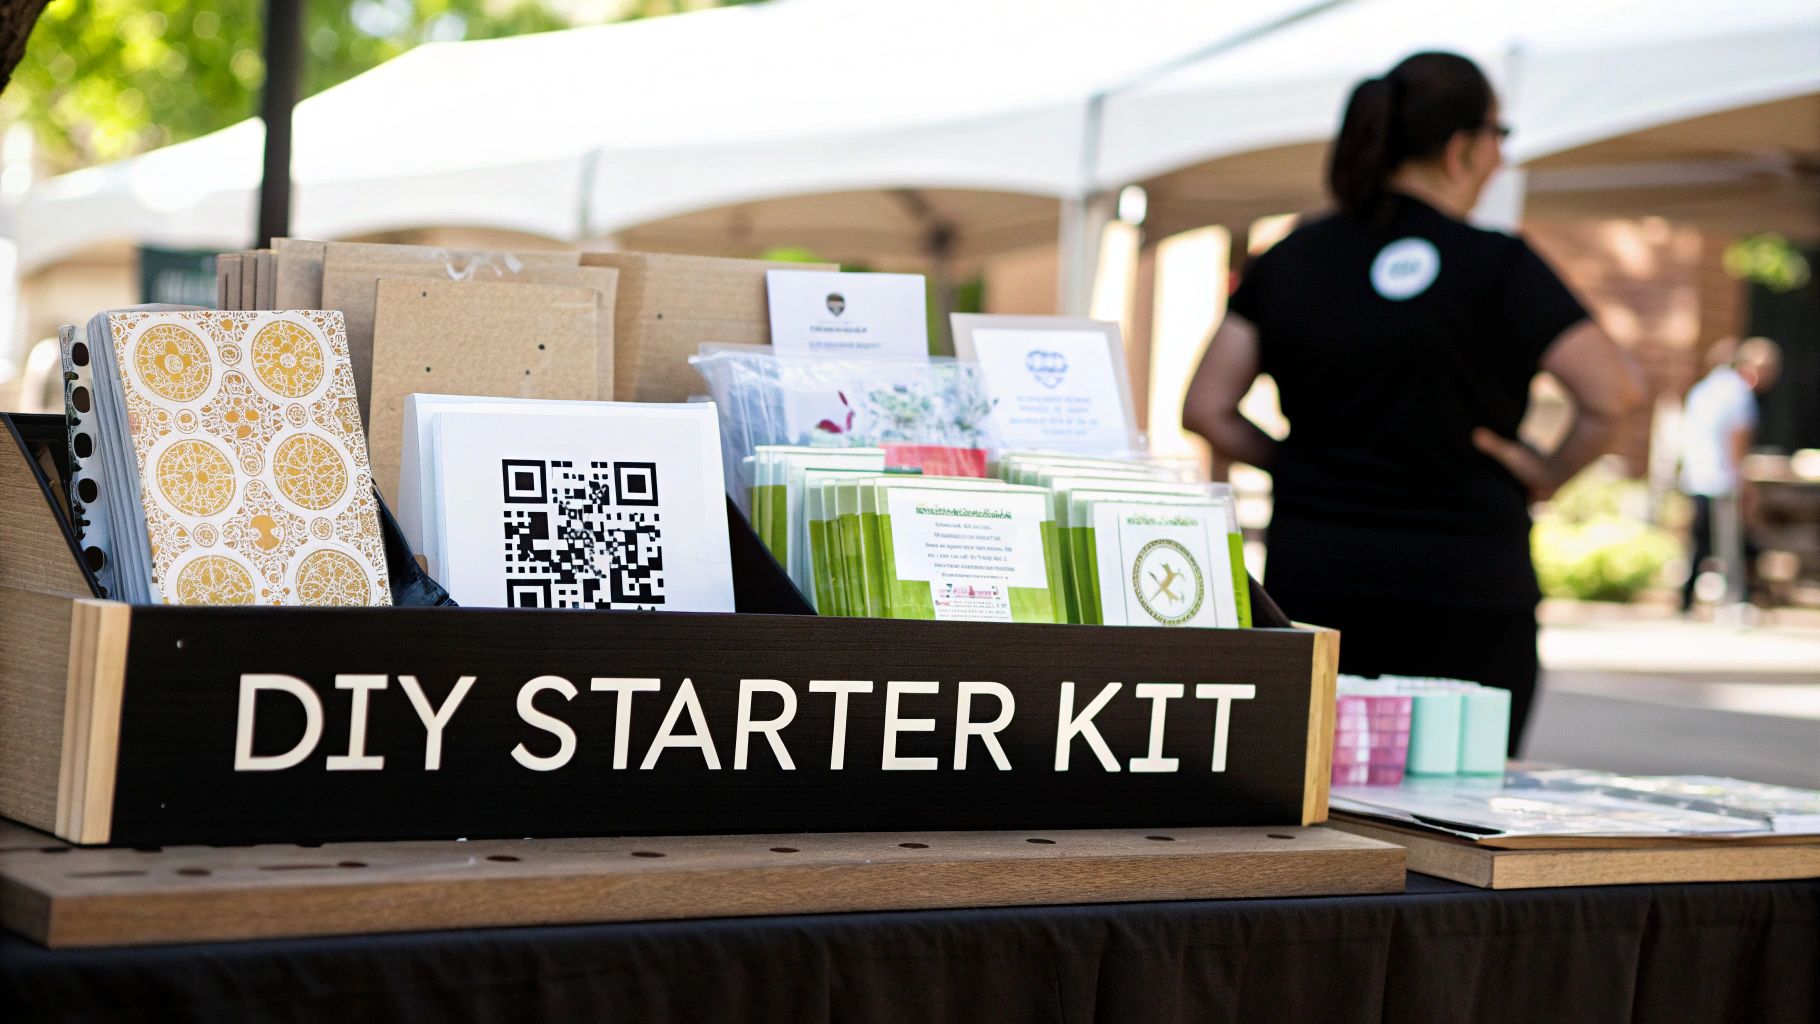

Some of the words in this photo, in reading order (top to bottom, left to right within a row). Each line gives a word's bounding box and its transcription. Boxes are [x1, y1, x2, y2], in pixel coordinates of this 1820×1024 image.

[234, 674, 477, 771] DIY
[511, 675, 1016, 772] STARTER
[1054, 681, 1256, 773] KIT
